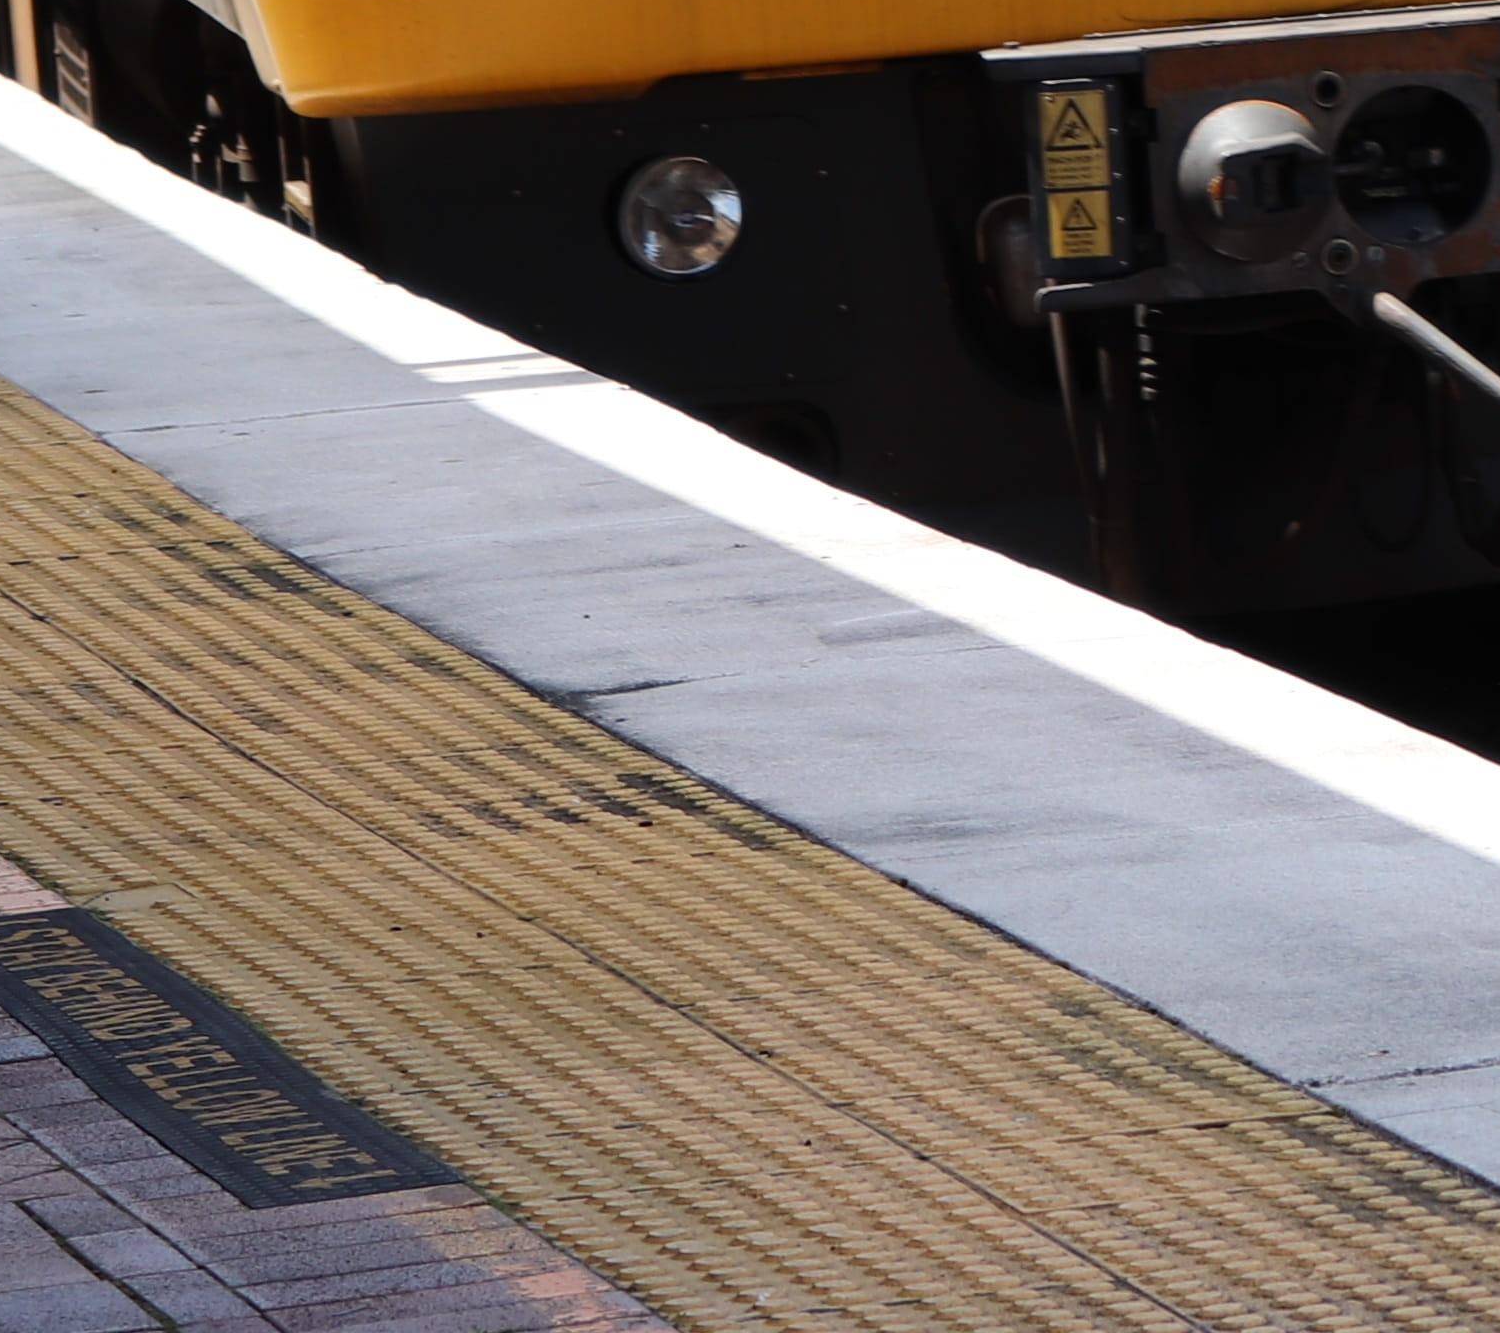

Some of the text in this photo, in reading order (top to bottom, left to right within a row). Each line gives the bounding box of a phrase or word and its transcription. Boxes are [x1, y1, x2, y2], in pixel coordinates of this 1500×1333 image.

[22, 967, 193, 1040] BEHIND
[115, 1035, 309, 1127] YELLOW
[219, 1121, 378, 1176] LINE
